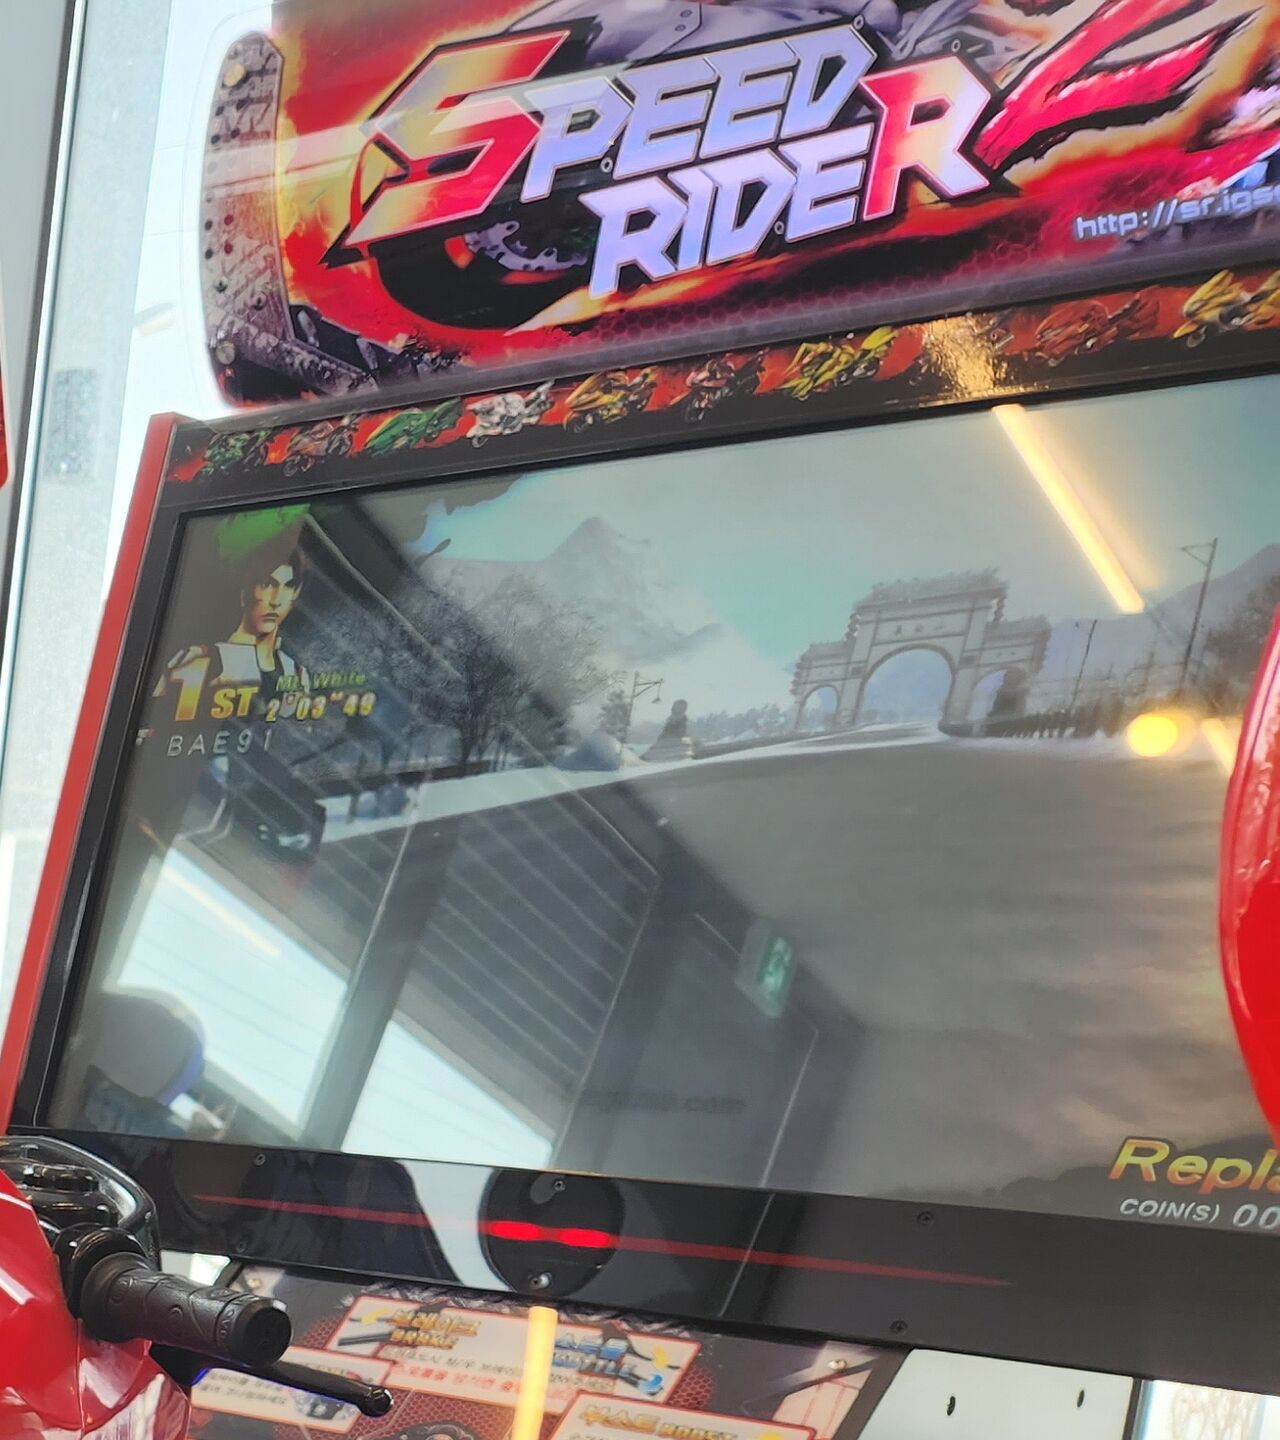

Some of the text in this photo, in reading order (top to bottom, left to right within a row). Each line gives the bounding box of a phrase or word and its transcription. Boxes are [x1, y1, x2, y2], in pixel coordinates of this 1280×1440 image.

[342, 26, 877, 246] SPEED
[580, 56, 991, 300] RIDER
[1119, 1198, 1220, 1224] COIN(S)
